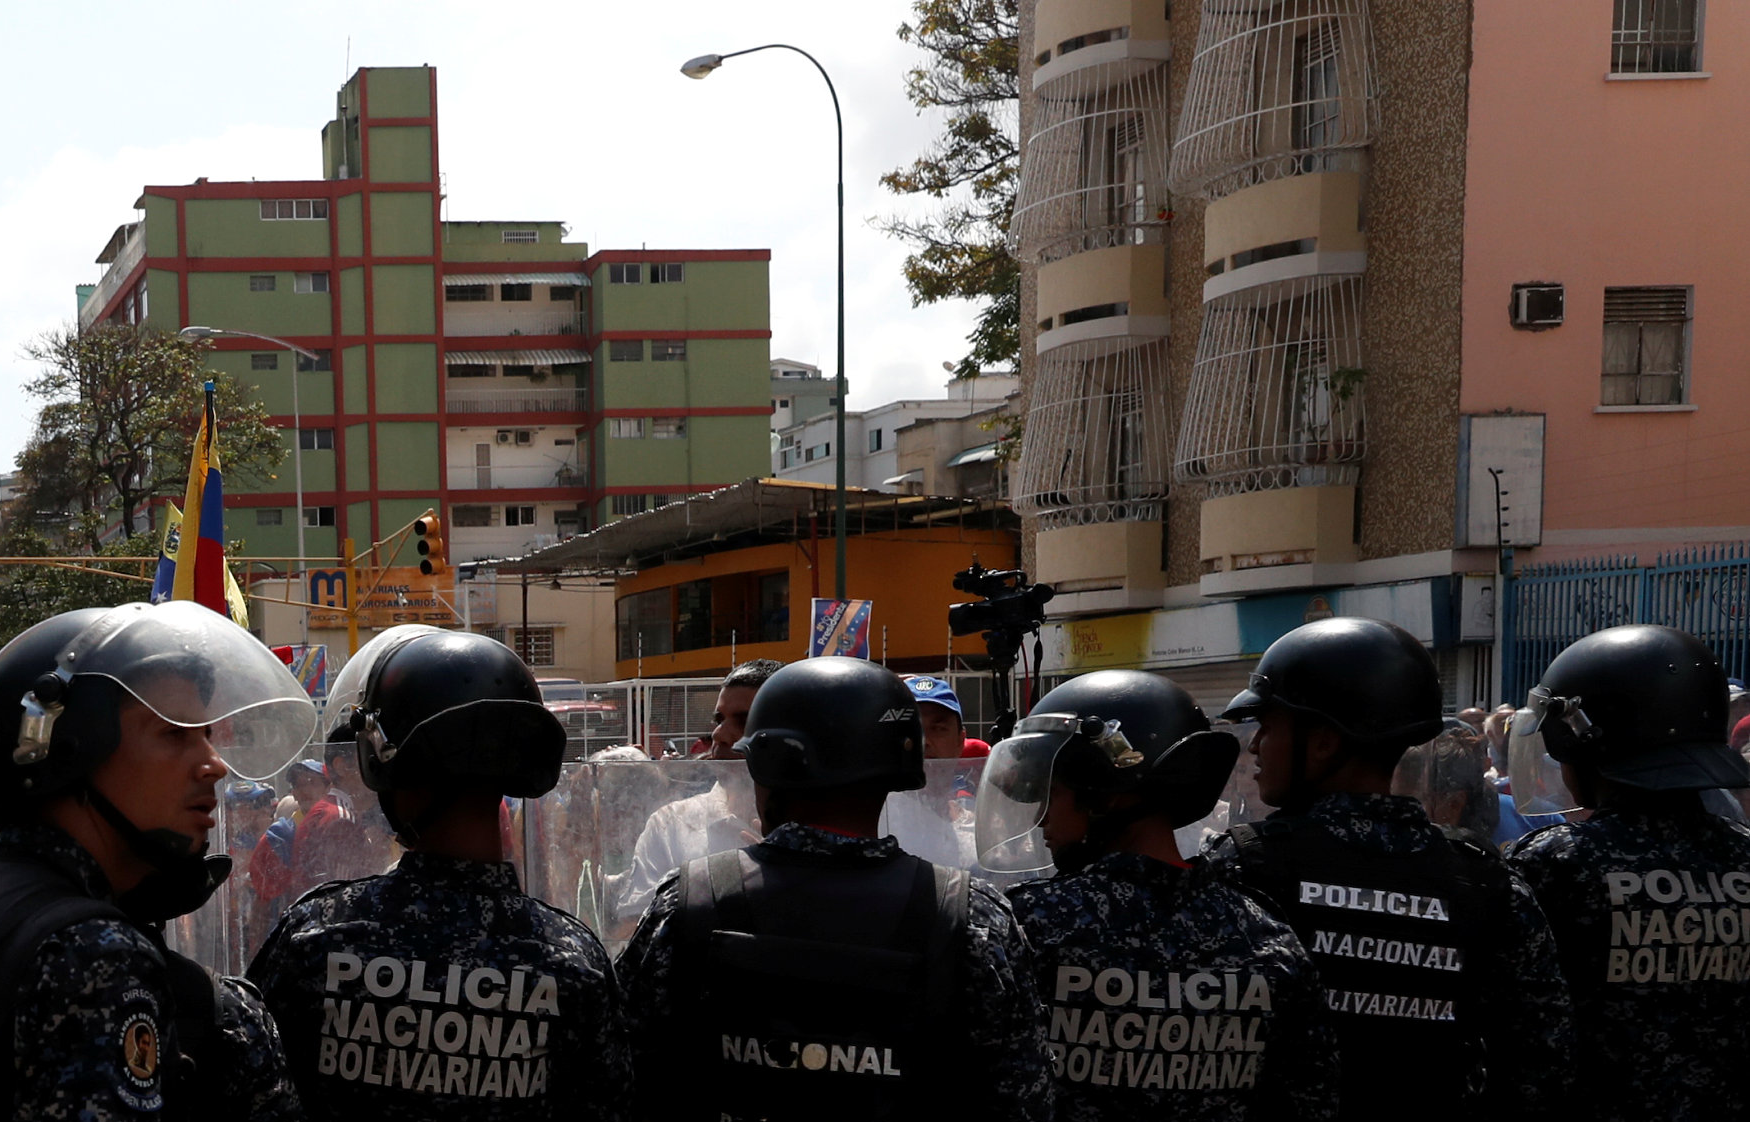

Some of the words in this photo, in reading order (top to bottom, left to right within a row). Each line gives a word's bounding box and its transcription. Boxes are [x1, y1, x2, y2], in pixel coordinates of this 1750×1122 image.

[1298, 880, 1450, 922] POLICIA
[1311, 929, 1462, 972] NACIONAL
[1606, 944, 1750, 984] BOLIVAR
[324, 951, 561, 1017] POLICÍA
[1054, 964, 1273, 1012] POLICÍA
[1326, 988, 1455, 1021] LIVARIANA
[320, 997, 550, 1060] NACIONAL
[1049, 1006, 1266, 1053] NACIONAL
[317, 1036, 549, 1099] BOLIVARIANA
[1047, 1041, 1258, 1090] BOLIVARIANA
